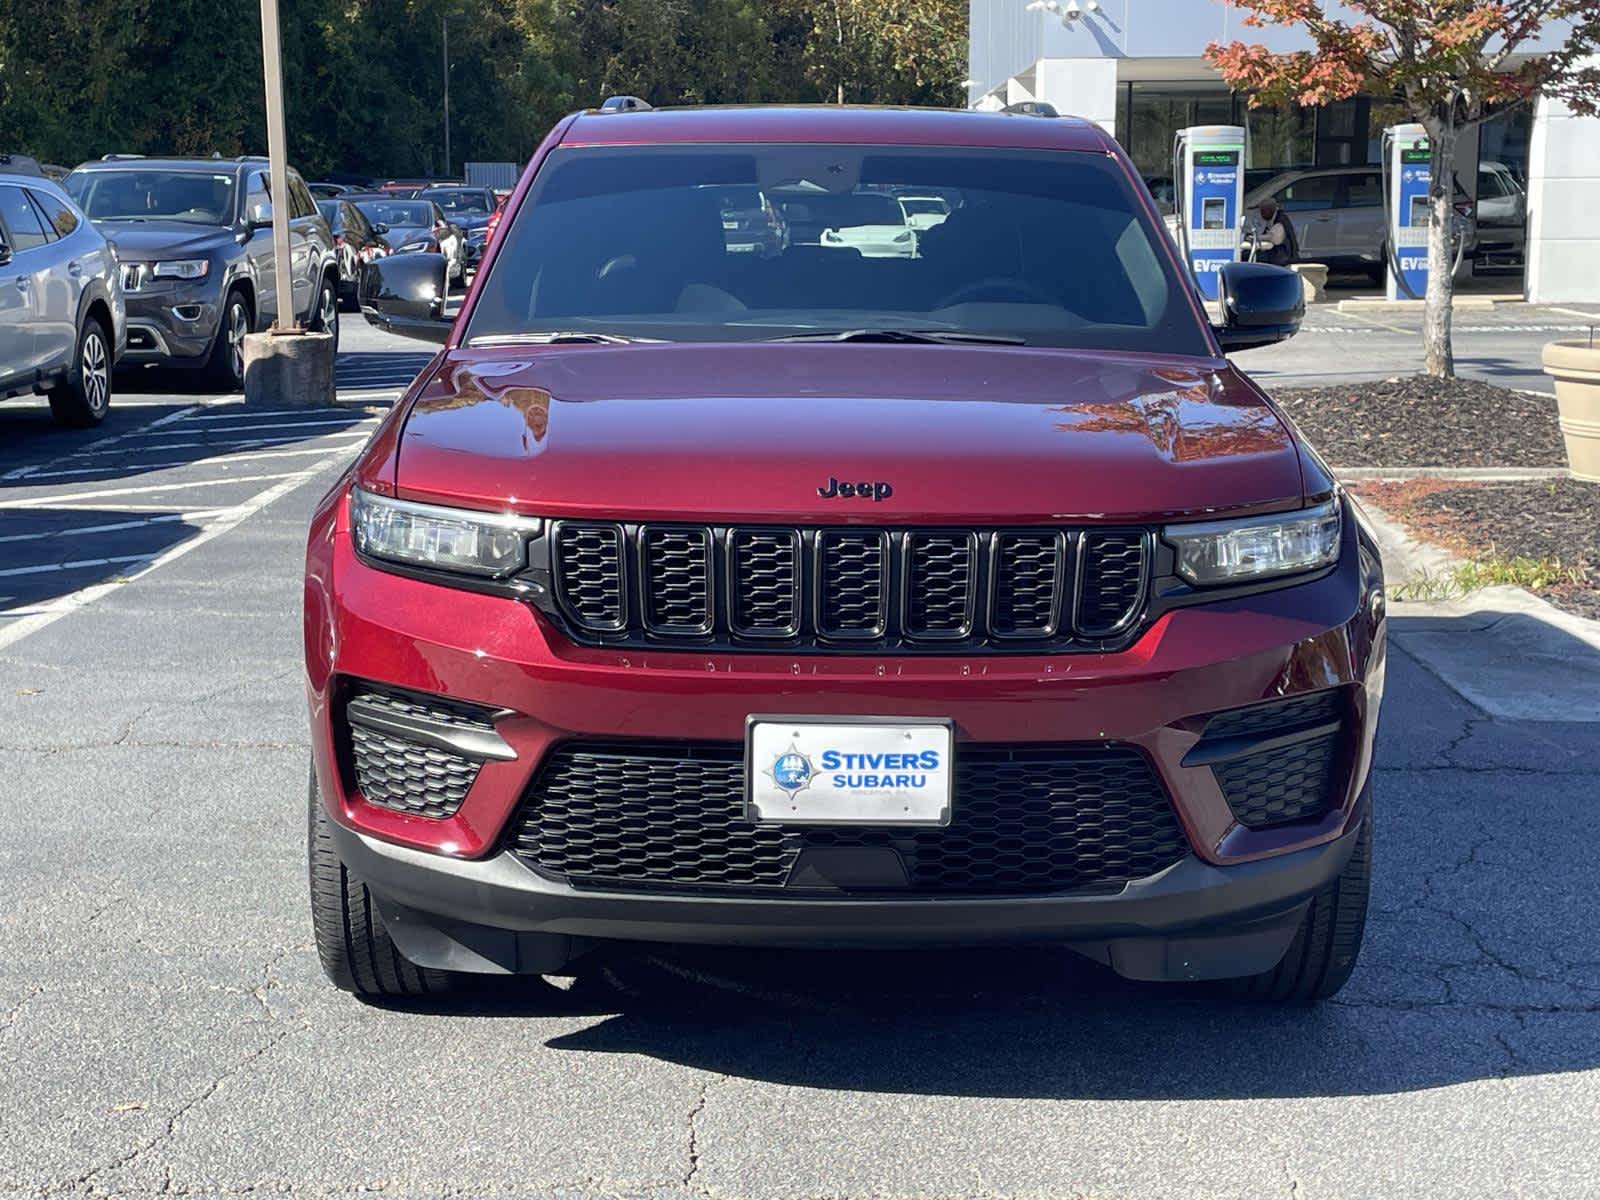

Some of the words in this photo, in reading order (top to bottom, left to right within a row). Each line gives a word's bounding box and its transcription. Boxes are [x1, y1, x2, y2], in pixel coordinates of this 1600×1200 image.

[1193, 259, 1211, 272] EV
[1401, 257, 1418, 271] EV
[816, 477, 893, 502] Jeep
[821, 750, 940, 770] STIVERS
[832, 774, 927, 788] SUBARU
